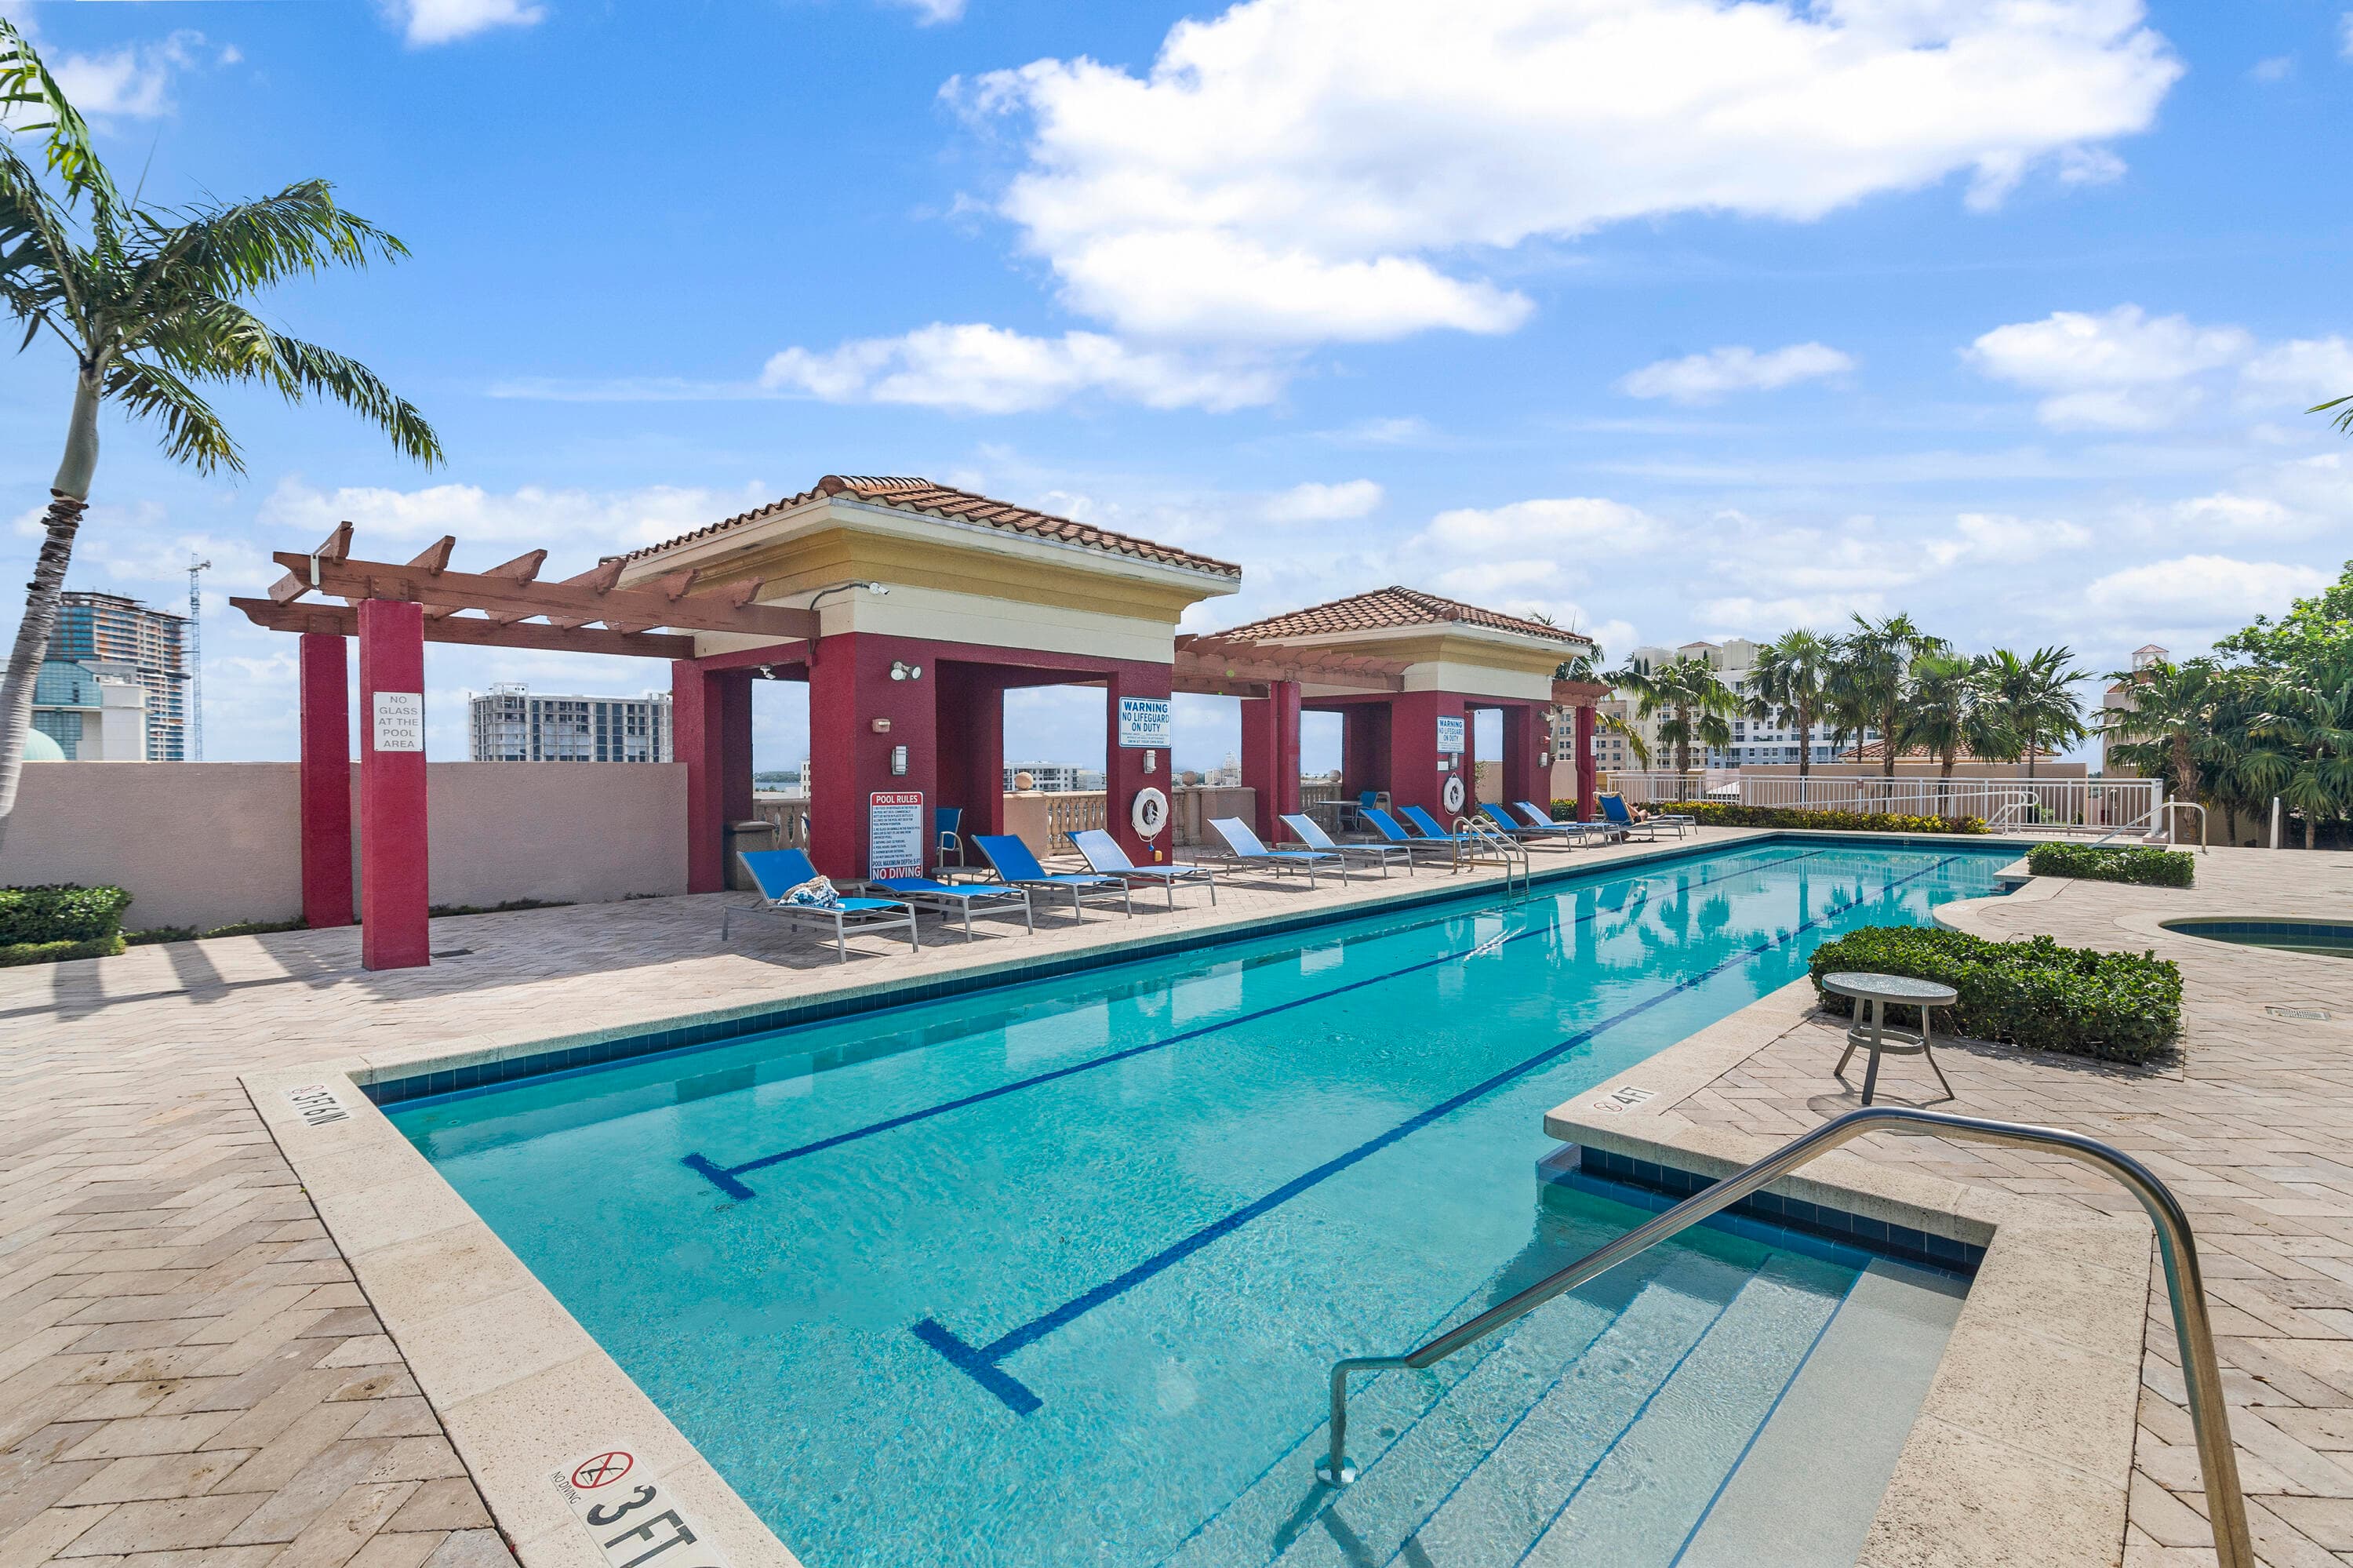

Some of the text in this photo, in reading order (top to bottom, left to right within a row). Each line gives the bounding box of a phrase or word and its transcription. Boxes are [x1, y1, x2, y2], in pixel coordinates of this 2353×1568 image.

[379, 707, 418, 715] GLASS
[1124, 701, 1168, 713] WARNING
[1122, 712, 1169, 723] NO LIFEGUARD
[383, 729, 416, 737] POOL
[1132, 722, 1161, 733] ON DUTY
[876, 795, 918, 804] POOL RULES
[872, 866, 921, 880] NO DIVING
[552, 1471, 582, 1504] NO DIVING
[587, 1484, 698, 1568] 3 FT
